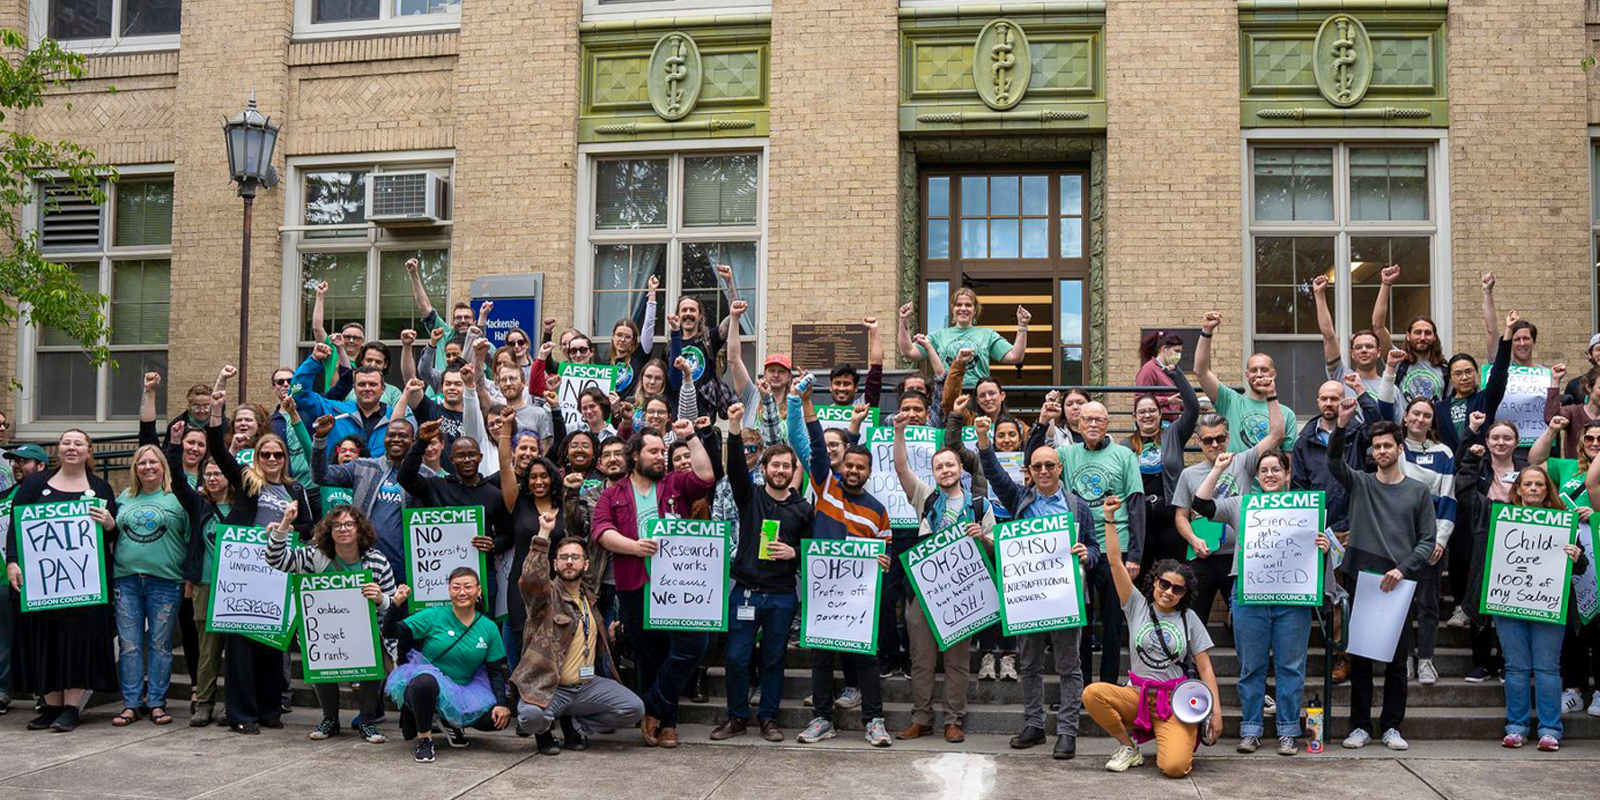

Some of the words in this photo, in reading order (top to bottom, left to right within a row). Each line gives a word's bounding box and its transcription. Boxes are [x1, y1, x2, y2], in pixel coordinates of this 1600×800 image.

[563, 365, 613, 379] AFSCME
[817, 408, 874, 422] AFSCE
[871, 427, 937, 442] AFCME
[1246, 493, 1319, 509] AFSCME
[410, 509, 476, 524] AFSCME
[1248, 510, 1308, 528] Science
[1497, 506, 1573, 527] AFSCME
[653, 520, 725, 536] AFSCME
[999, 514, 1069, 539] AFSCME
[26, 519, 95, 552] FAIR
[222, 526, 294, 549] AFSCE
[415, 526, 443, 546] NO
[908, 521, 967, 566] AFSCME
[659, 538, 719, 558] Research
[808, 541, 879, 558] AFSCME
[1006, 537, 1057, 558] OHSU
[1246, 538, 1302, 550] EASIER
[416, 545, 468, 560] Diversity
[1246, 551, 1273, 559] when
[1506, 550, 1542, 565] Care
[417, 559, 442, 573] NO
[672, 559, 707, 571] works
[811, 558, 864, 580] OHSU
[920, 540, 974, 583] OHSU
[1003, 556, 1064, 578] EXPLOITS
[1263, 560, 1283, 569] well
[38, 554, 89, 595] PAY
[300, 573, 365, 590] AFSCME
[659, 573, 707, 587] because
[1247, 568, 1308, 585] RESTED
[1497, 573, 1533, 587] 100%
[218, 580, 248, 593] NOT
[417, 574, 450, 595] Equit
[851, 584, 868, 596] off
[1003, 577, 1071, 593] INTERNATIONAL
[27, 598, 59, 607] OREGON
[60, 595, 91, 604] COUNCIL
[222, 596, 282, 617] RESPECTED
[652, 591, 677, 606] We
[1006, 592, 1047, 605] WORKERS
[815, 609, 867, 628] poverty!
[1485, 603, 1517, 613] OREGON
[1517, 607, 1550, 618] COUNCIL
[242, 623, 273, 631] COUNCIL
[1007, 621, 1038, 631] OREGON
[1038, 618, 1070, 627] COUNCIL
[805, 637, 834, 645] OREGON
[834, 640, 863, 649] COUNCIL
[943, 627, 970, 644] OREGON
